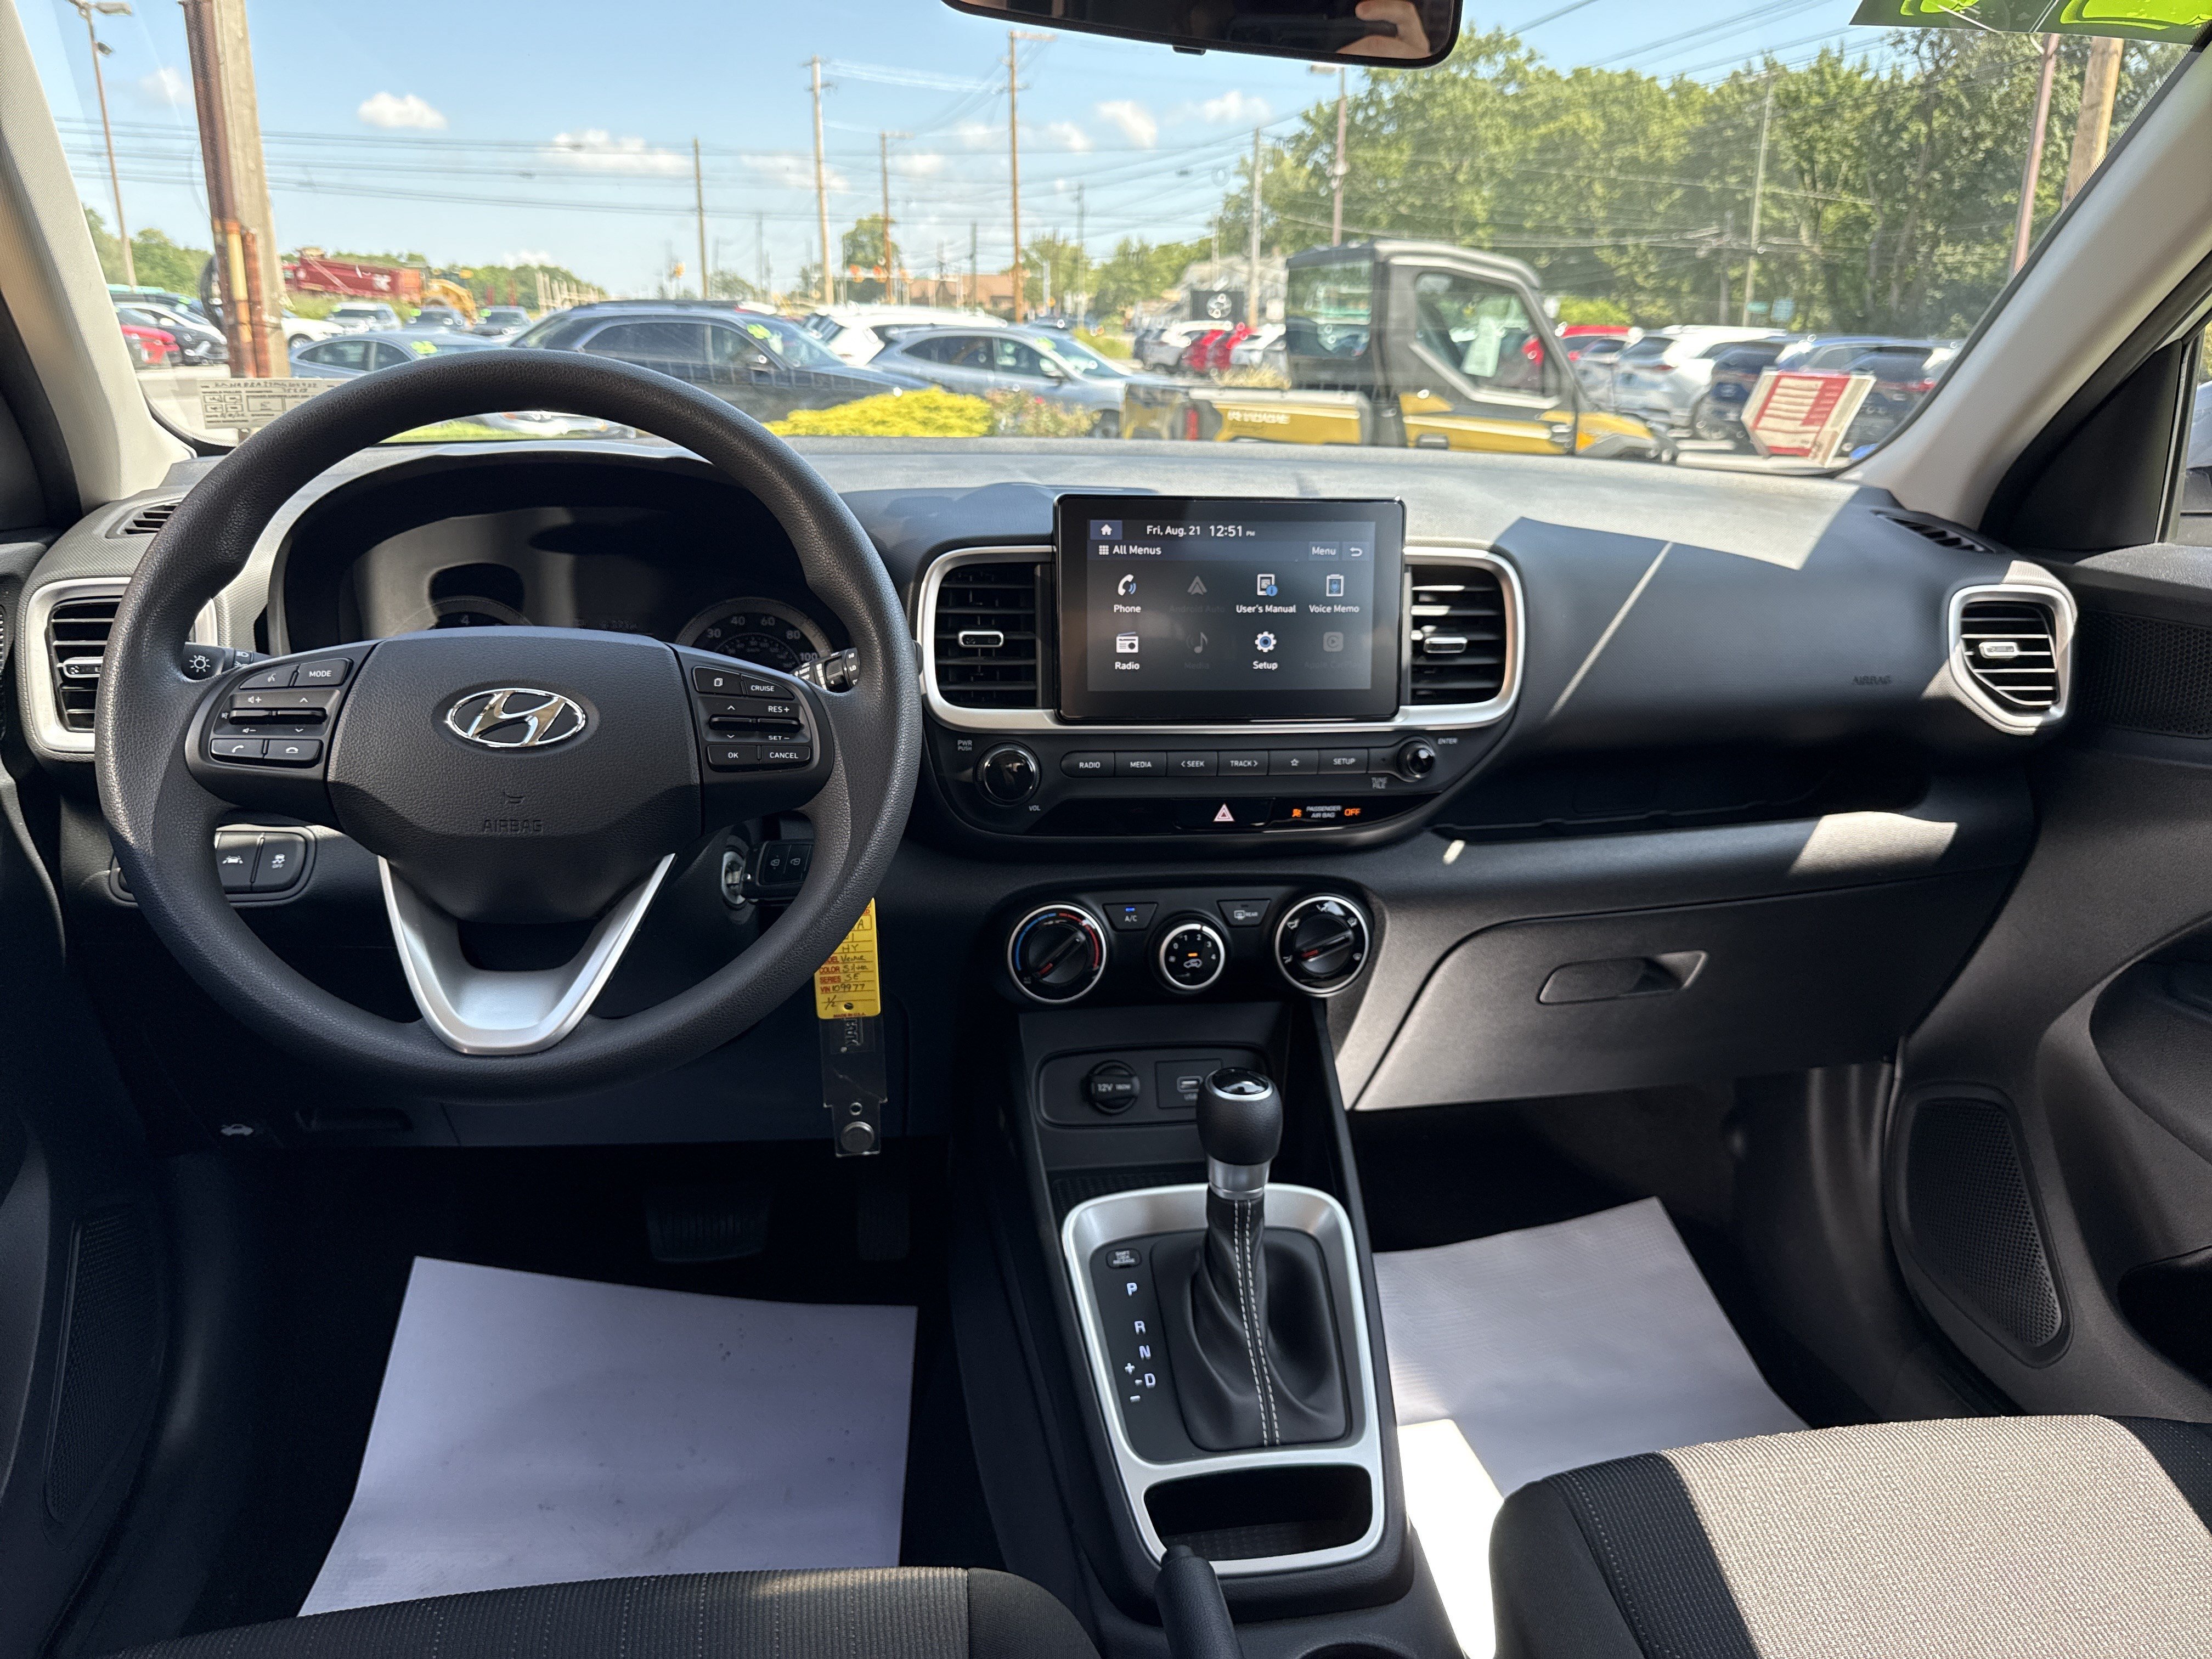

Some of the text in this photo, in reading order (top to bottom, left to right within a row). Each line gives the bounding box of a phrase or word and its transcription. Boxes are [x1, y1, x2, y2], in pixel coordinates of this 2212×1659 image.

[1146, 525, 1163, 535] Fri,
[1165, 525, 1187, 537] Aug.
[1188, 525, 1201, 535] 21
[1209, 525, 1243, 537] 12:51
[1112, 545, 1162, 555] All Menus
[1312, 546, 1336, 555] Menu
[1113, 604, 1142, 613] Phone
[1236, 604, 1296, 613] User's Manual
[1309, 605, 1360, 613] Voice Memo
[730, 616, 746, 625] 40
[760, 616, 775, 626] 60
[786, 630, 800, 640] 80
[799, 652, 818, 662] 100
[1115, 661, 1141, 670] Radio
[1252, 661, 1278, 670] Setup
[1344, 808, 1361, 817] OFF
[482, 819, 545, 833] AIRBAG
[842, 944, 859, 953] HY
[819, 966, 840, 974] COLOR
[820, 976, 842, 984] SERIES
[1127, 1282, 1137, 1296] P
[1134, 1321, 1146, 1334] R
[1139, 1345, 1151, 1359] N
[1144, 1373, 1156, 1389] D
